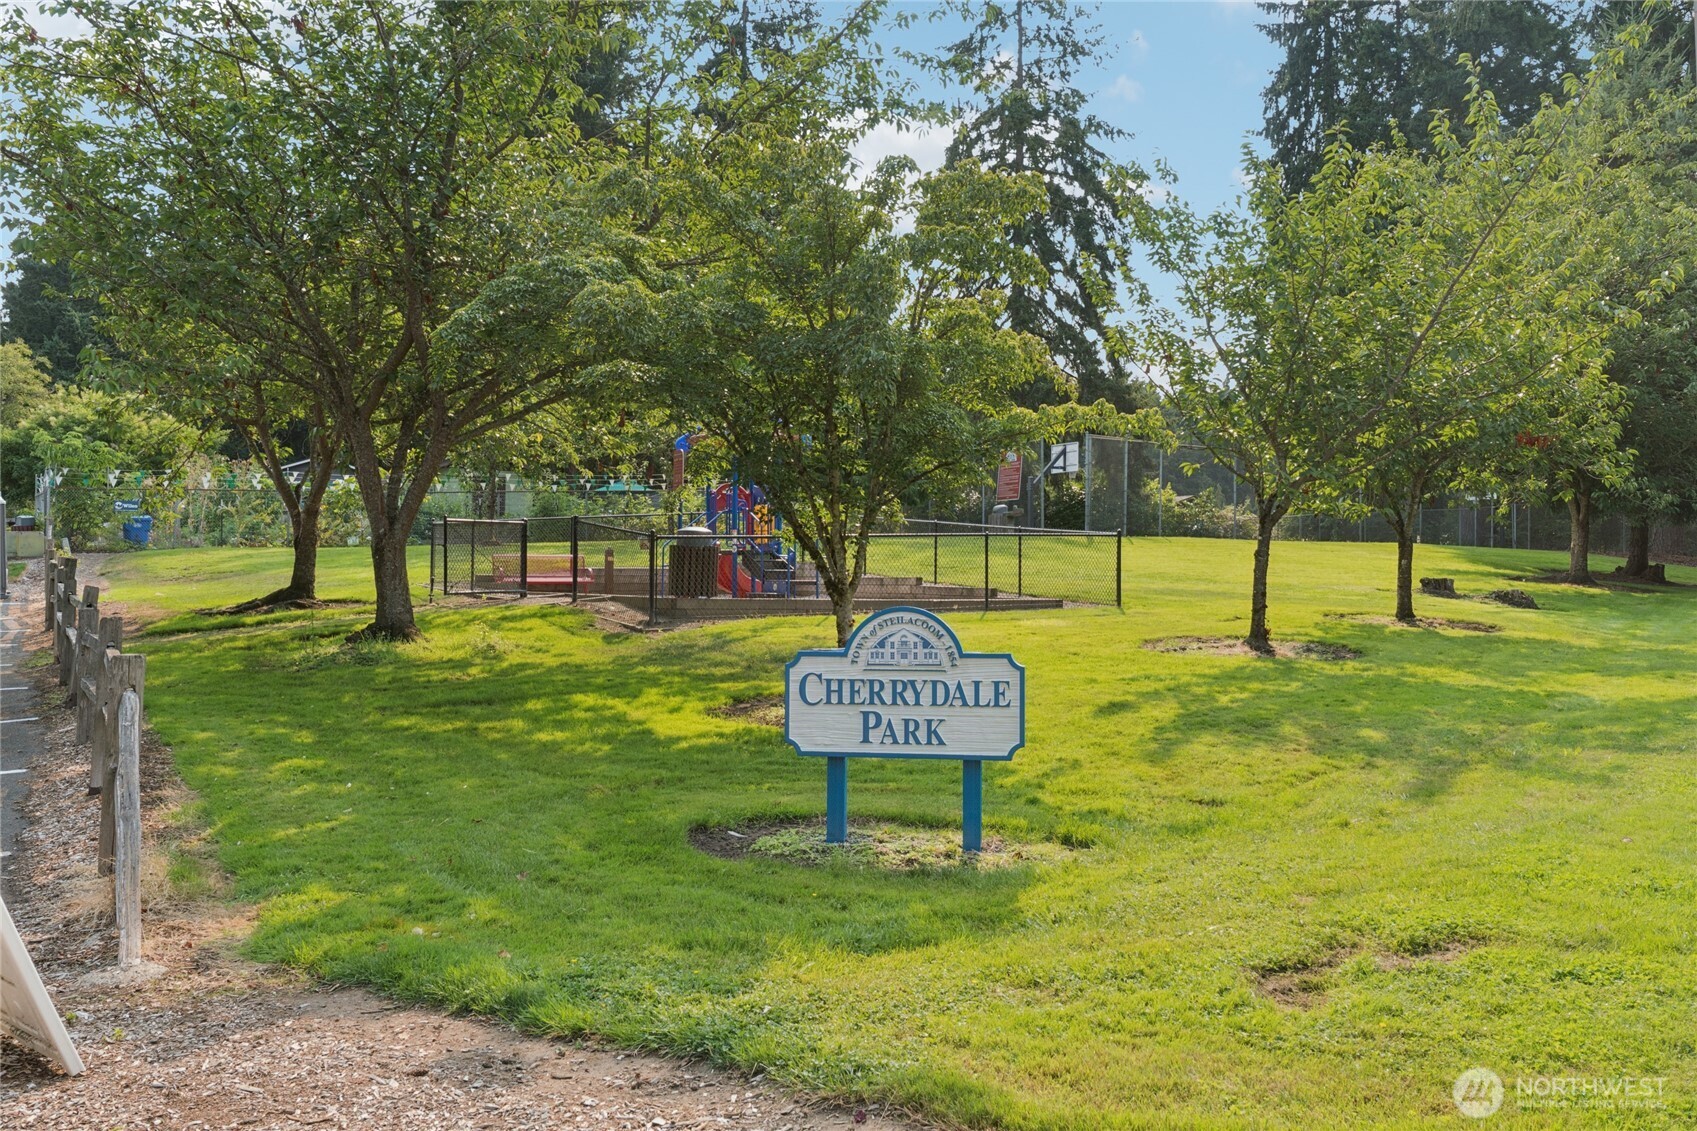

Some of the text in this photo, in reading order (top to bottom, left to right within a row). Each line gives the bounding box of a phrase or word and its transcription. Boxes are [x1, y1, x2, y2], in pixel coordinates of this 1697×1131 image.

[851, 634, 869, 665] TOWN
[869, 625, 878, 637] of
[877, 616, 944, 640] STEILACOOM
[799, 672, 1012, 707] CHERRYDALE
[860, 710, 946, 745] PARK
